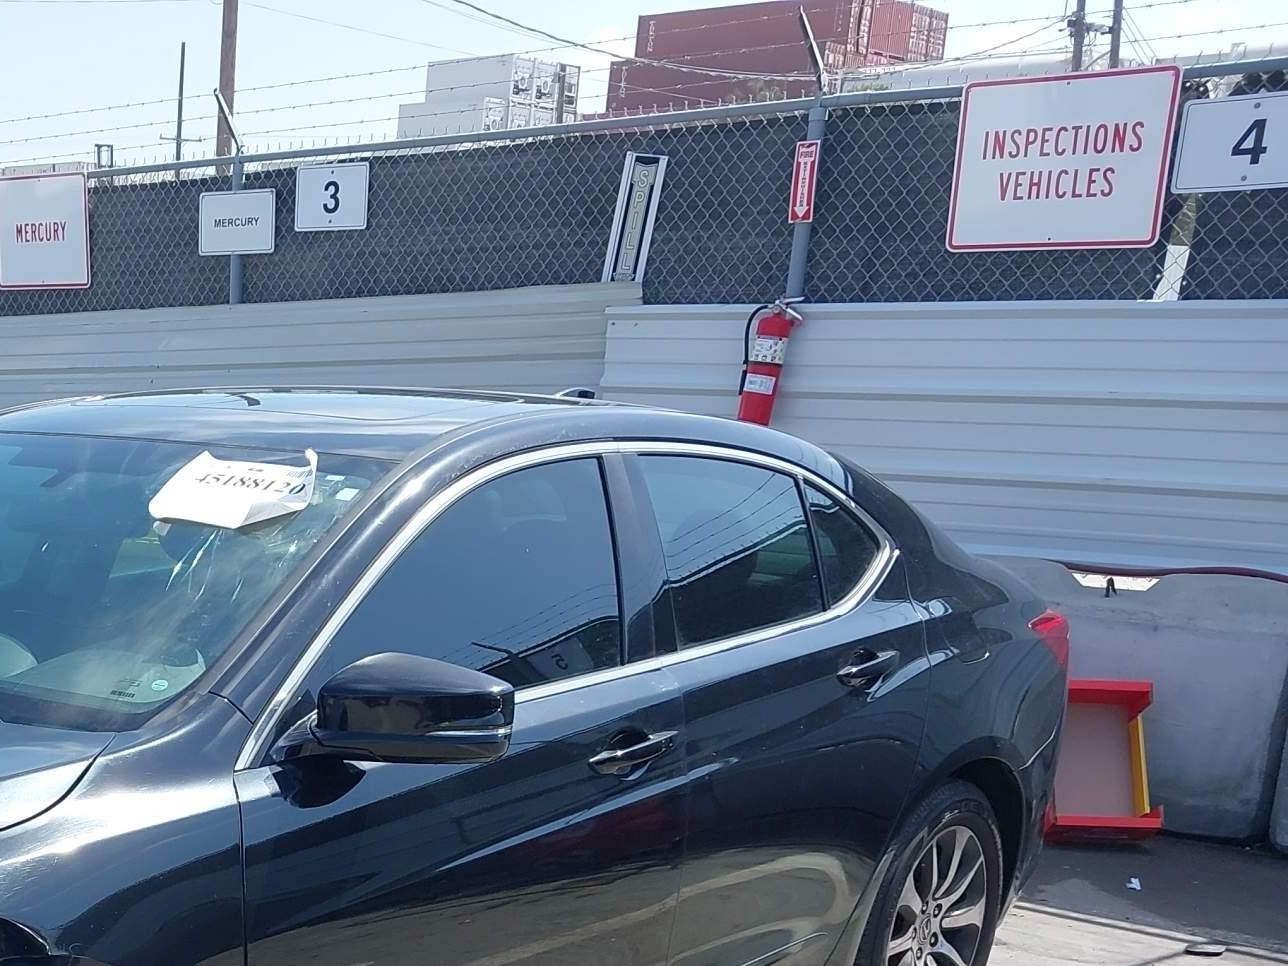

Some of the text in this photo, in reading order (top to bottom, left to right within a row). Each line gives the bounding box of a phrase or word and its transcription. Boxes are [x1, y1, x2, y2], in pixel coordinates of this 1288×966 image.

[982, 121, 1145, 160] INSPECTIONS
[1230, 118, 1268, 165] 4
[322, 180, 340, 214] 3
[999, 167, 1116, 201] VEHICLES
[15, 221, 67, 244] MERCURY
[214, 216, 260, 229] MERCURY
[621, 170, 649, 271] SPILL
[194, 473, 306, 496] 45188120
